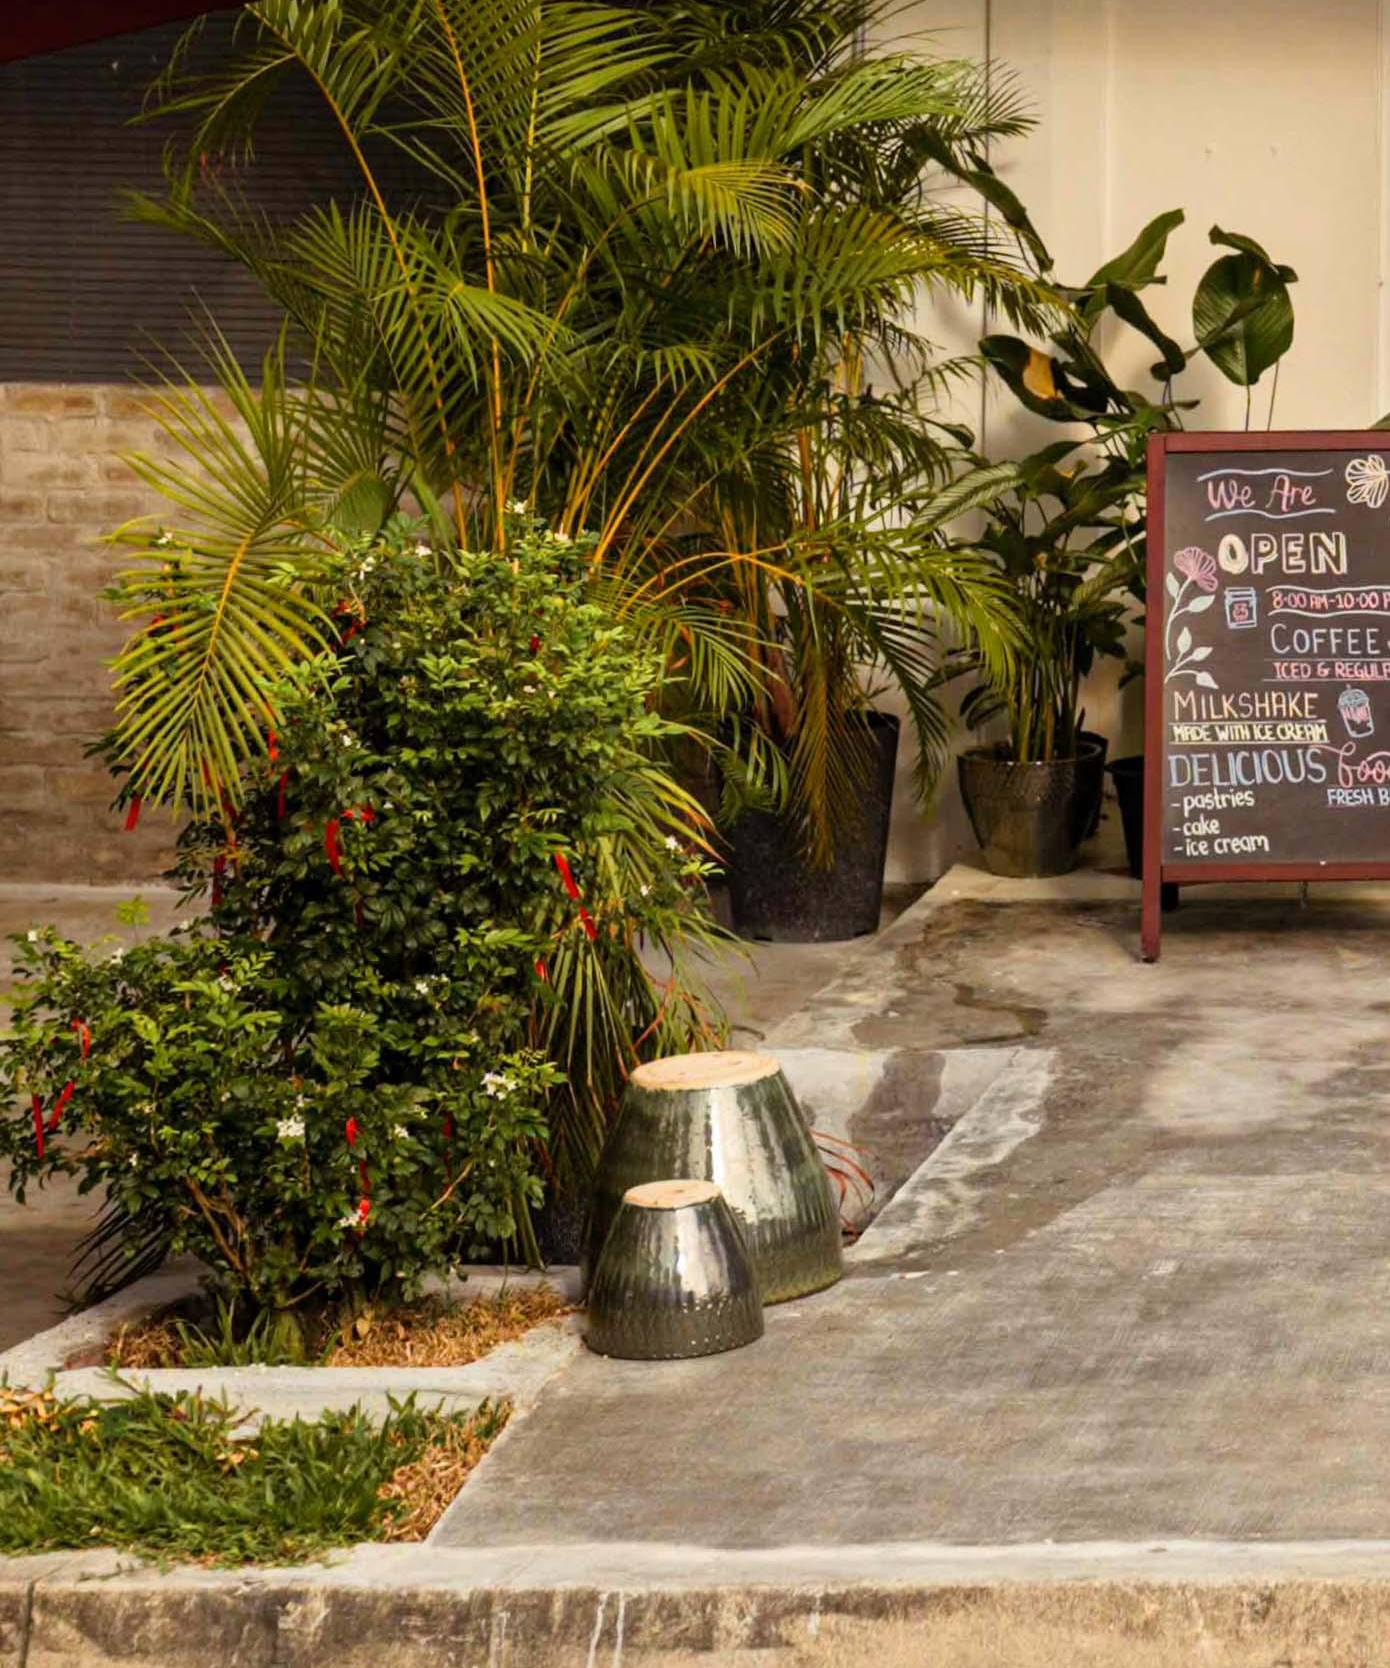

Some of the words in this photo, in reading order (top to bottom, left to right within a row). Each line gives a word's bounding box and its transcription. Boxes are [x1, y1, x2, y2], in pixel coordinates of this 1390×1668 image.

[1207, 479, 1256, 510] We
[1265, 474, 1317, 512] Are
[1217, 531, 1348, 576] OPEN
[1269, 623, 1381, 655] COFFEE
[1273, 662, 1312, 679] ICED
[1316, 662, 1331, 678] &
[1173, 690, 1319, 721] MILKSHAKE
[1172, 724, 1211, 743] MADE
[1215, 724, 1251, 743] WITH
[1252, 724, 1276, 742] ICE
[1277, 723, 1329, 742] CREAM
[1167, 747, 1327, 788] DELICIOUS
[1326, 787, 1374, 807] FRESH
[1213, 833, 1271, 856] cream
